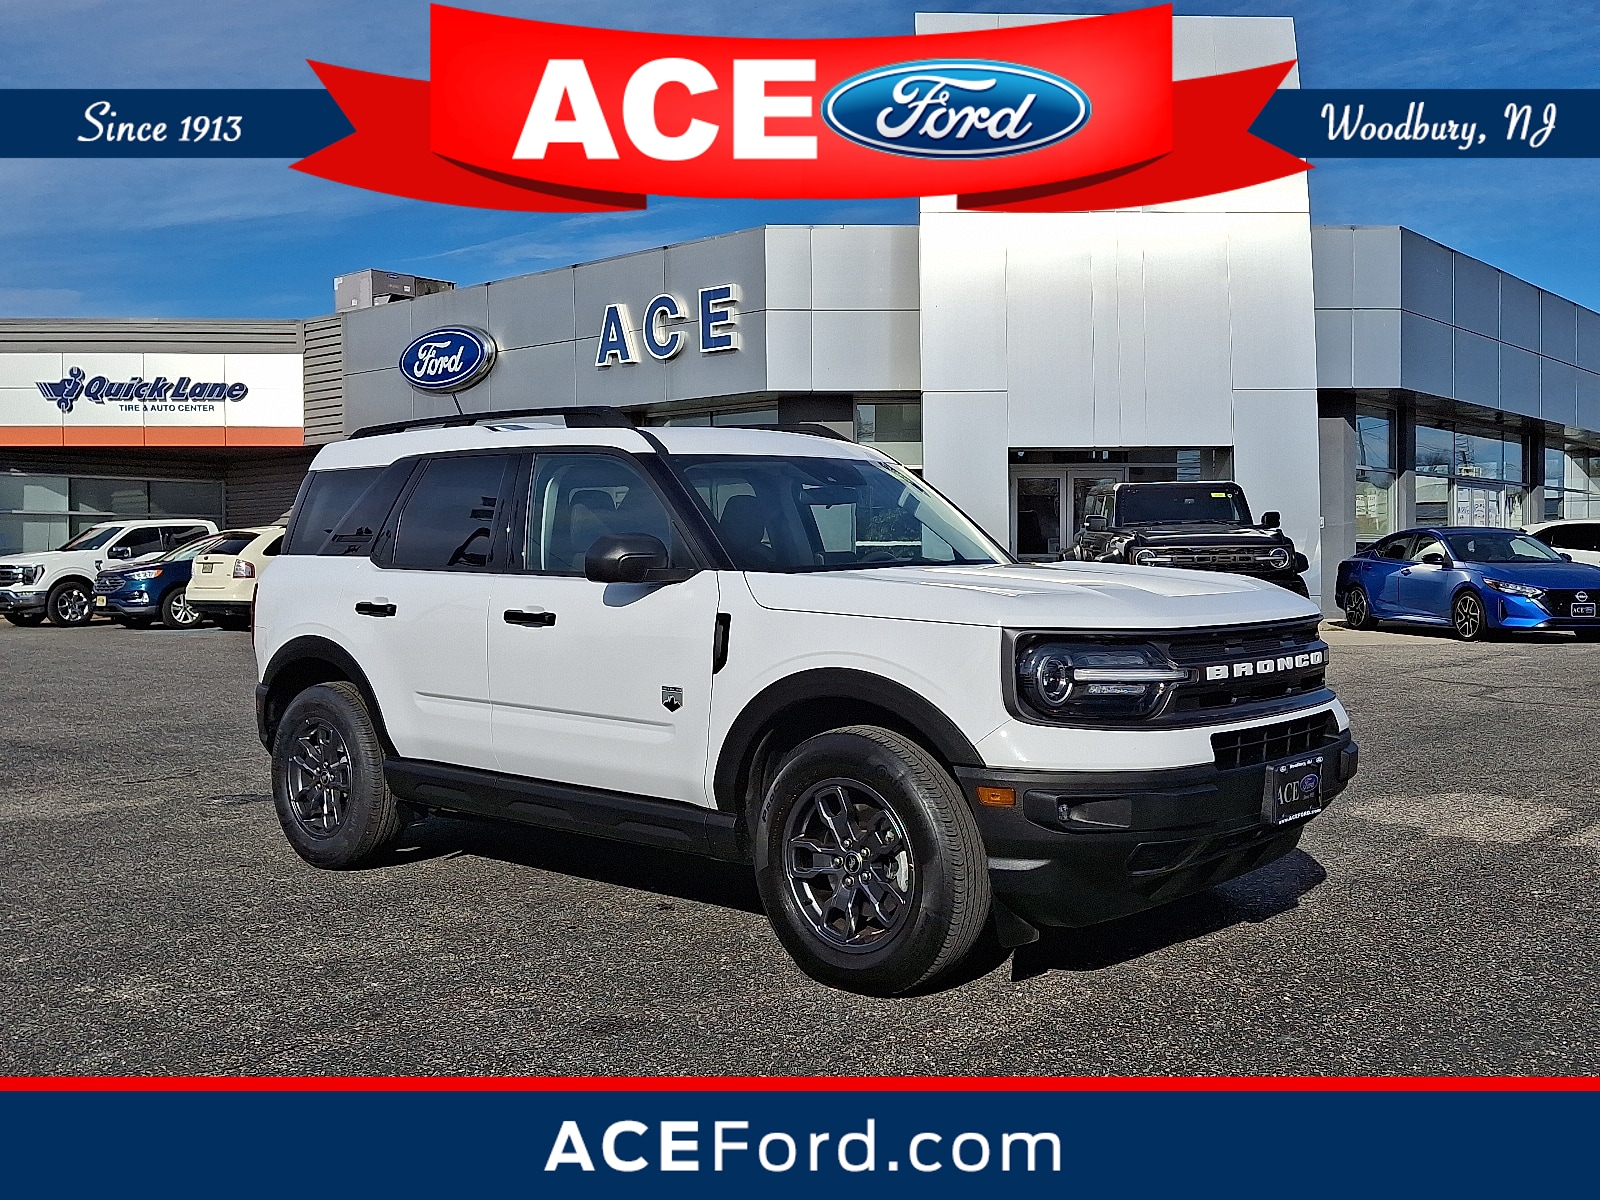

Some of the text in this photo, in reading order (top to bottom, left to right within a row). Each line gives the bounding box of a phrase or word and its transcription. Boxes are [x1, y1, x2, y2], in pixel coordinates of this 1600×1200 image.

[595, 283, 741, 368] ACE
[413, 340, 465, 378] Ford
[84, 375, 249, 405] Quick Lane
[119, 404, 140, 412] TIRE
[150, 404, 176, 412] AUTO
[177, 404, 215, 412] CENTER
[1206, 651, 1323, 681] BRONCO
[1277, 780, 1300, 805] ACE
